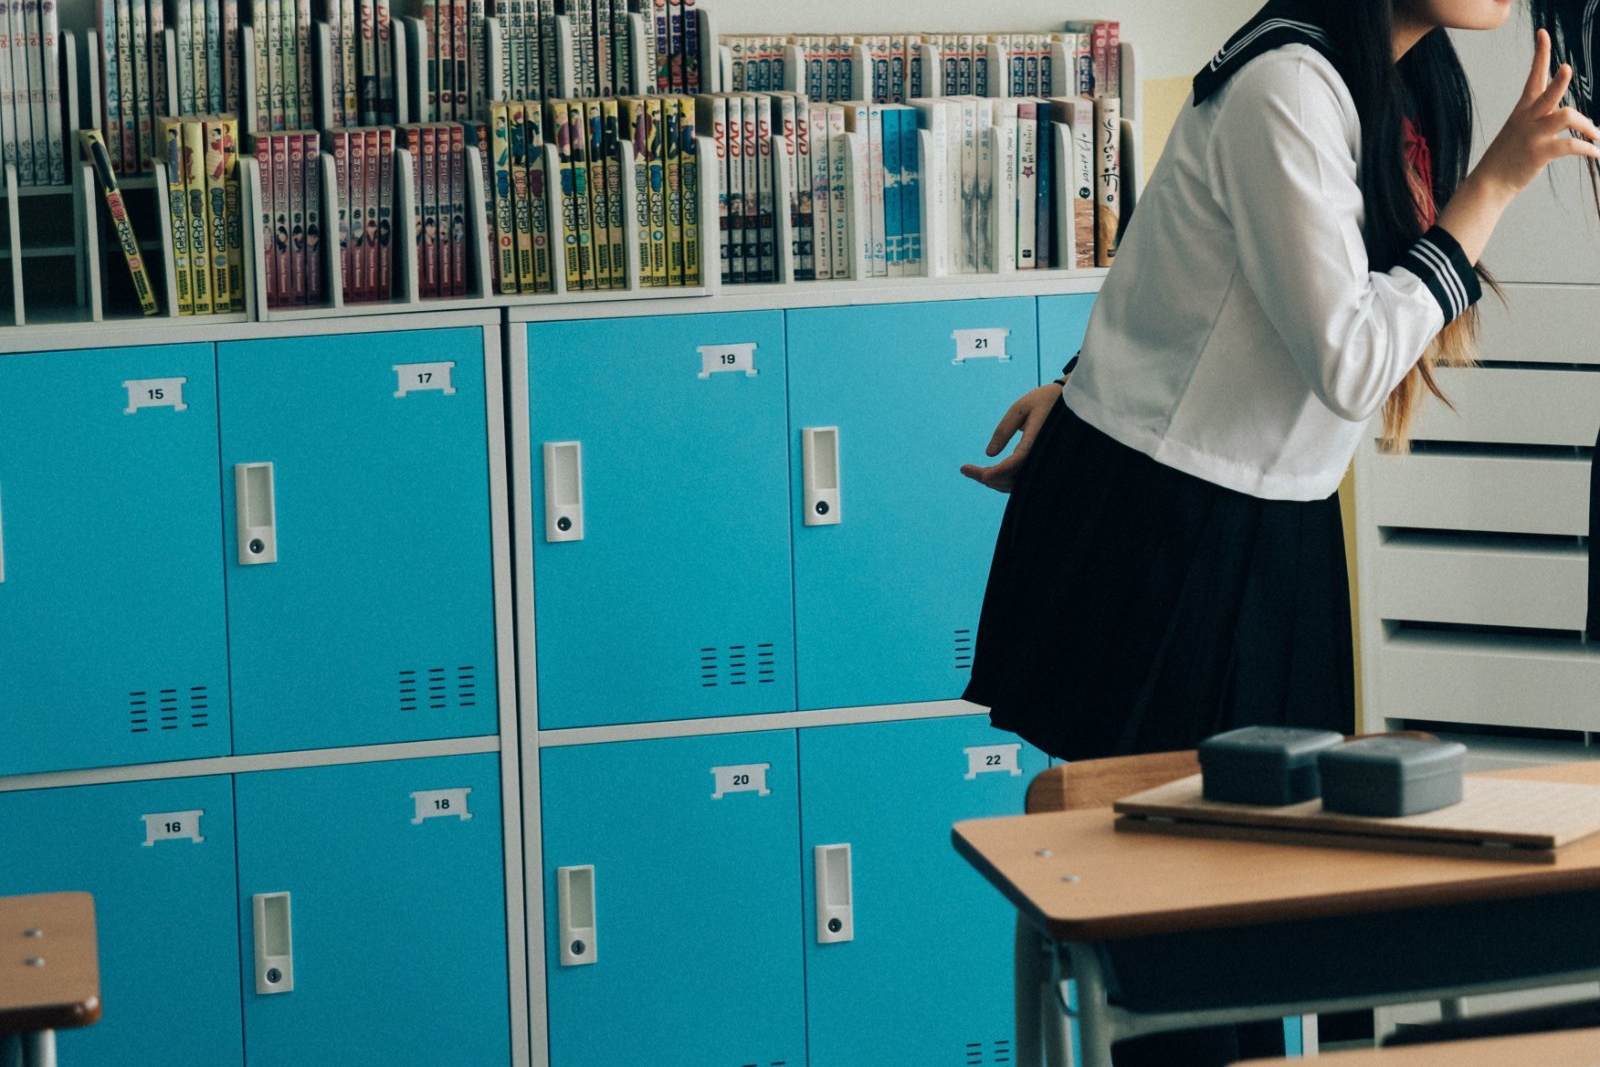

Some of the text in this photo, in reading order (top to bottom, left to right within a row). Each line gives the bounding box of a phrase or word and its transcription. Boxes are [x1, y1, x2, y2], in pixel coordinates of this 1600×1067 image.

[362, 4, 373, 40] DVD
[378, 4, 388, 42] DVD
[477, 42, 485, 87] RELOAD
[502, 42, 510, 88] RELOAD
[516, 42, 526, 88] RELOAD
[530, 42, 540, 86] RELOAD
[548, 40, 556, 86] RELOAD
[572, 40, 581, 85] RELOAD
[586, 40, 596, 84] RELOAD
[622, 38, 630, 84] RELOAD
[646, 36, 656, 82] RELOAD
[714, 122, 726, 158] DVD
[730, 120, 740, 158] DVD
[744, 120, 756, 158] DVD
[759, 118, 770, 156] DVD
[784, 119, 794, 156] DVD
[798, 118, 808, 156] DVD
[720, 353, 736, 366] 19
[974, 338, 988, 350] 21
[148, 388, 164, 400] 15
[416, 372, 432, 385] 17
[986, 754, 1001, 767] 22
[732, 774, 750, 786] 20
[434, 798, 450, 810] 18
[164, 820, 181, 834] 16
